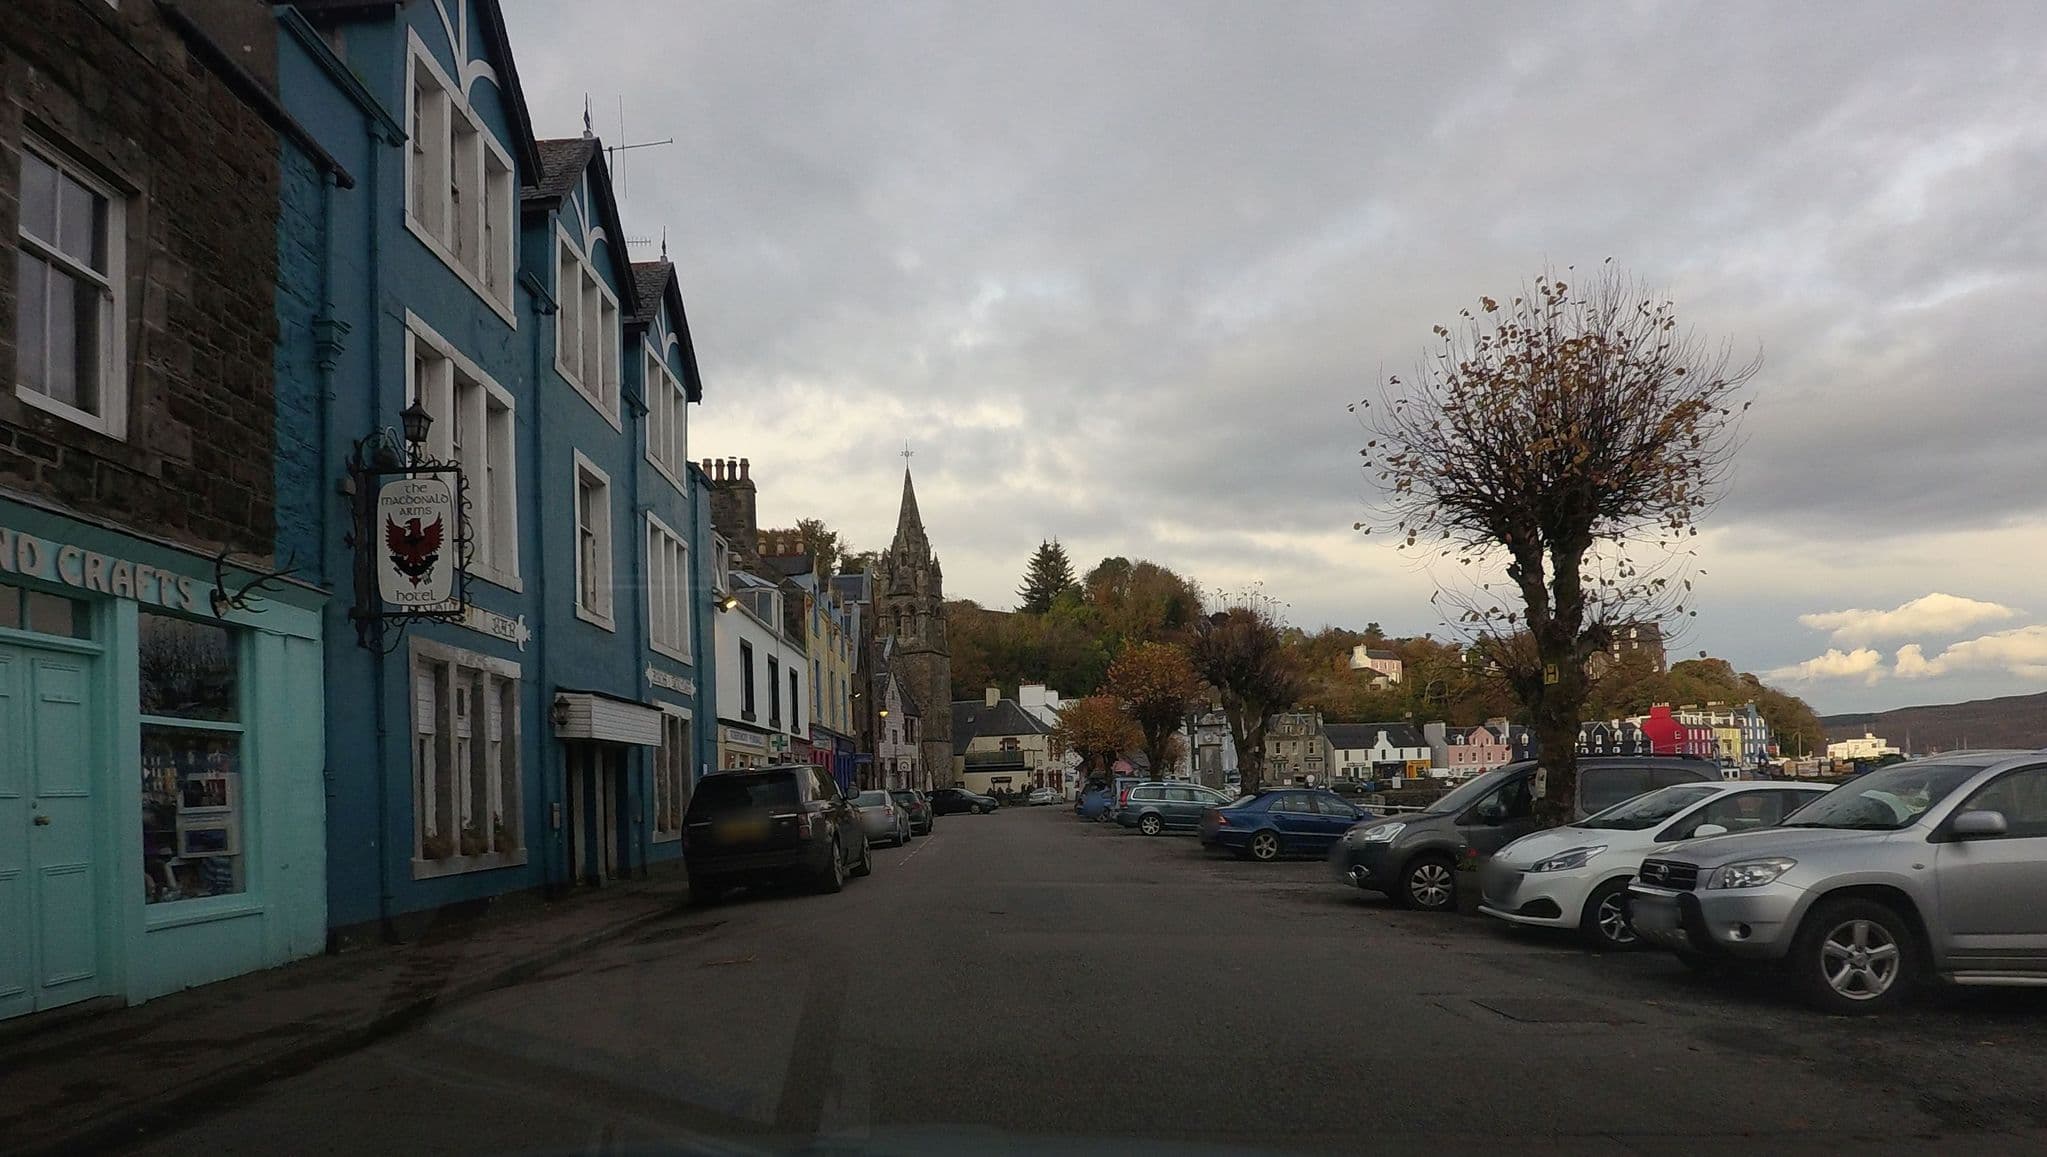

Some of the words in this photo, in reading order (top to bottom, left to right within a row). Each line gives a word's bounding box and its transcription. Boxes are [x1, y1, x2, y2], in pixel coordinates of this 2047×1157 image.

[404, 483, 428, 494] the
[57, 545, 193, 613] CRAFTS
[395, 590, 437, 602] hotel
